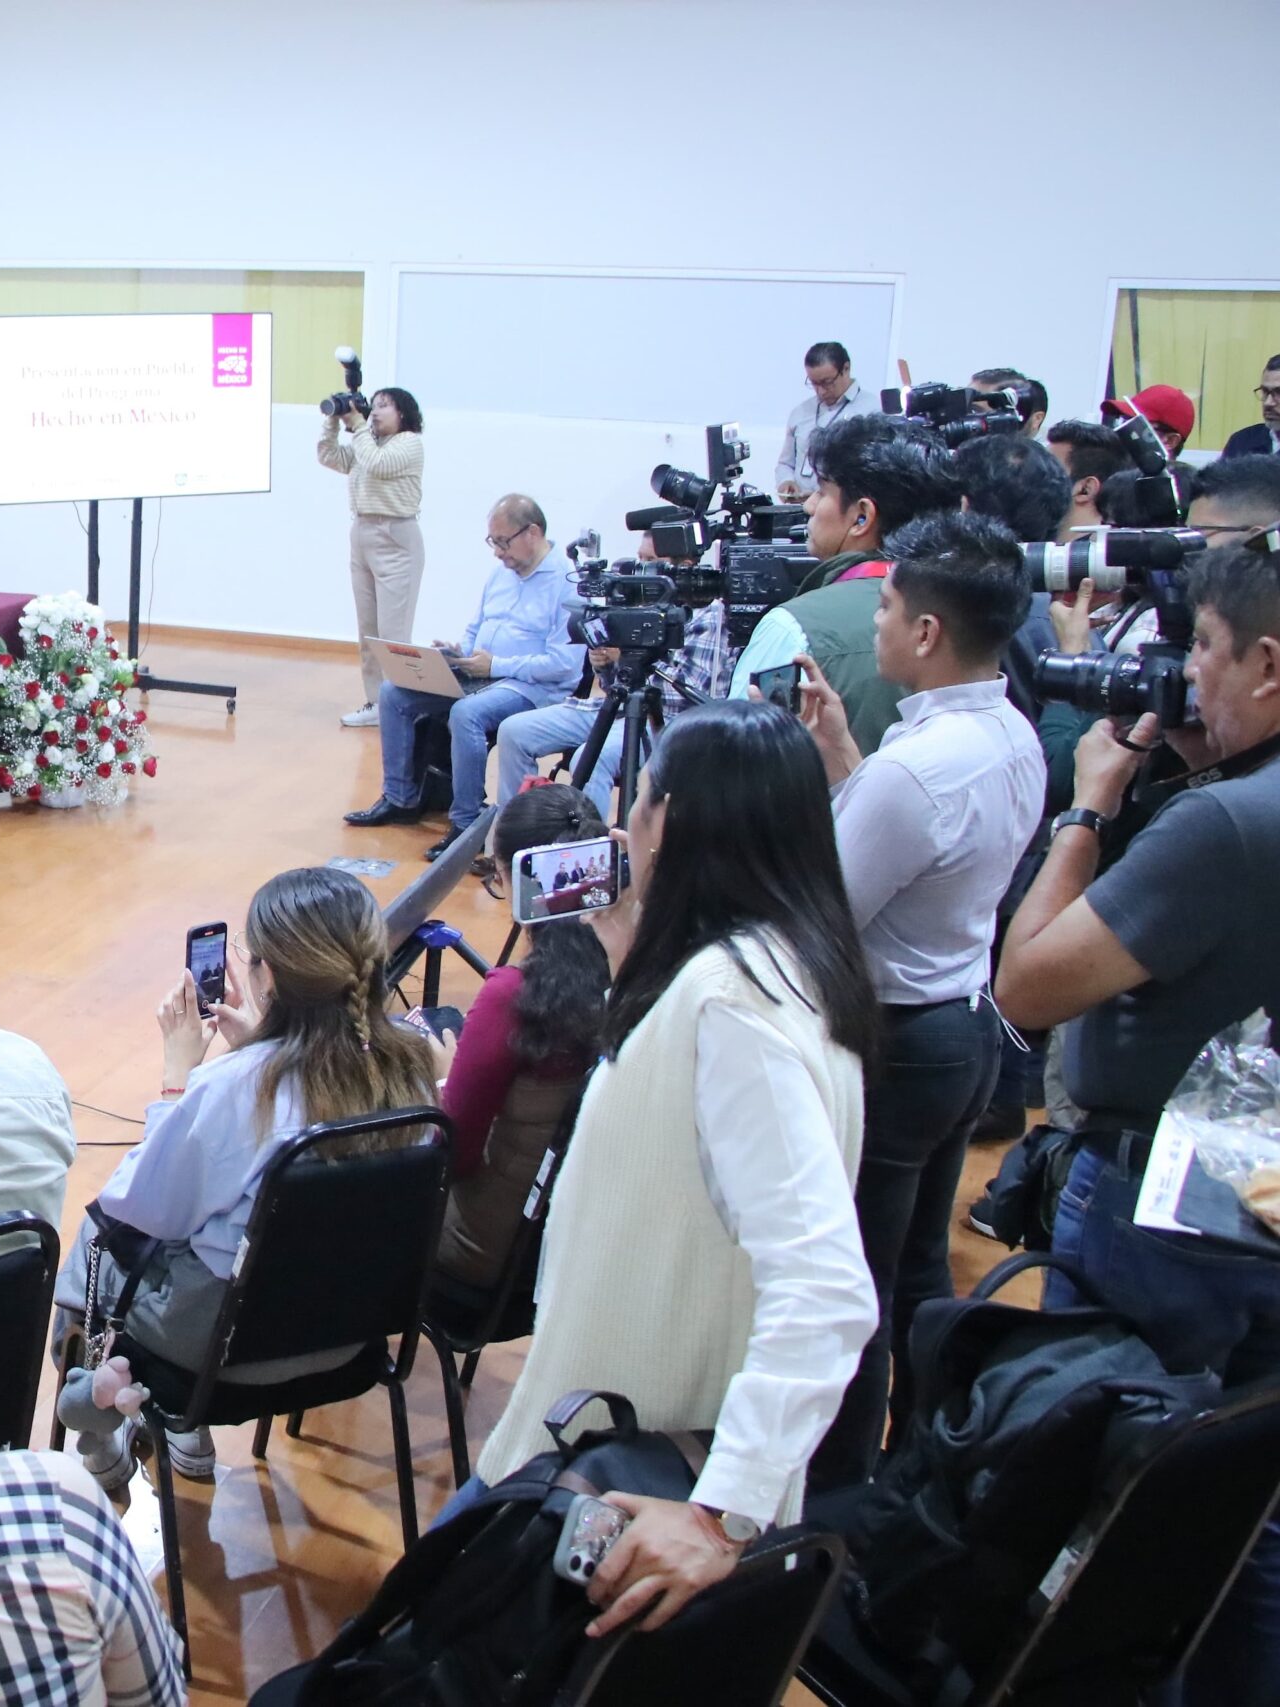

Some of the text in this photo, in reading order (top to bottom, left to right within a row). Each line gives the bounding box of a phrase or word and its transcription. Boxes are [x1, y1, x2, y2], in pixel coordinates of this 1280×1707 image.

[31, 410, 93, 428] Hecho
[100, 413, 122, 425] en
[1187, 768, 1222, 788] EOS
